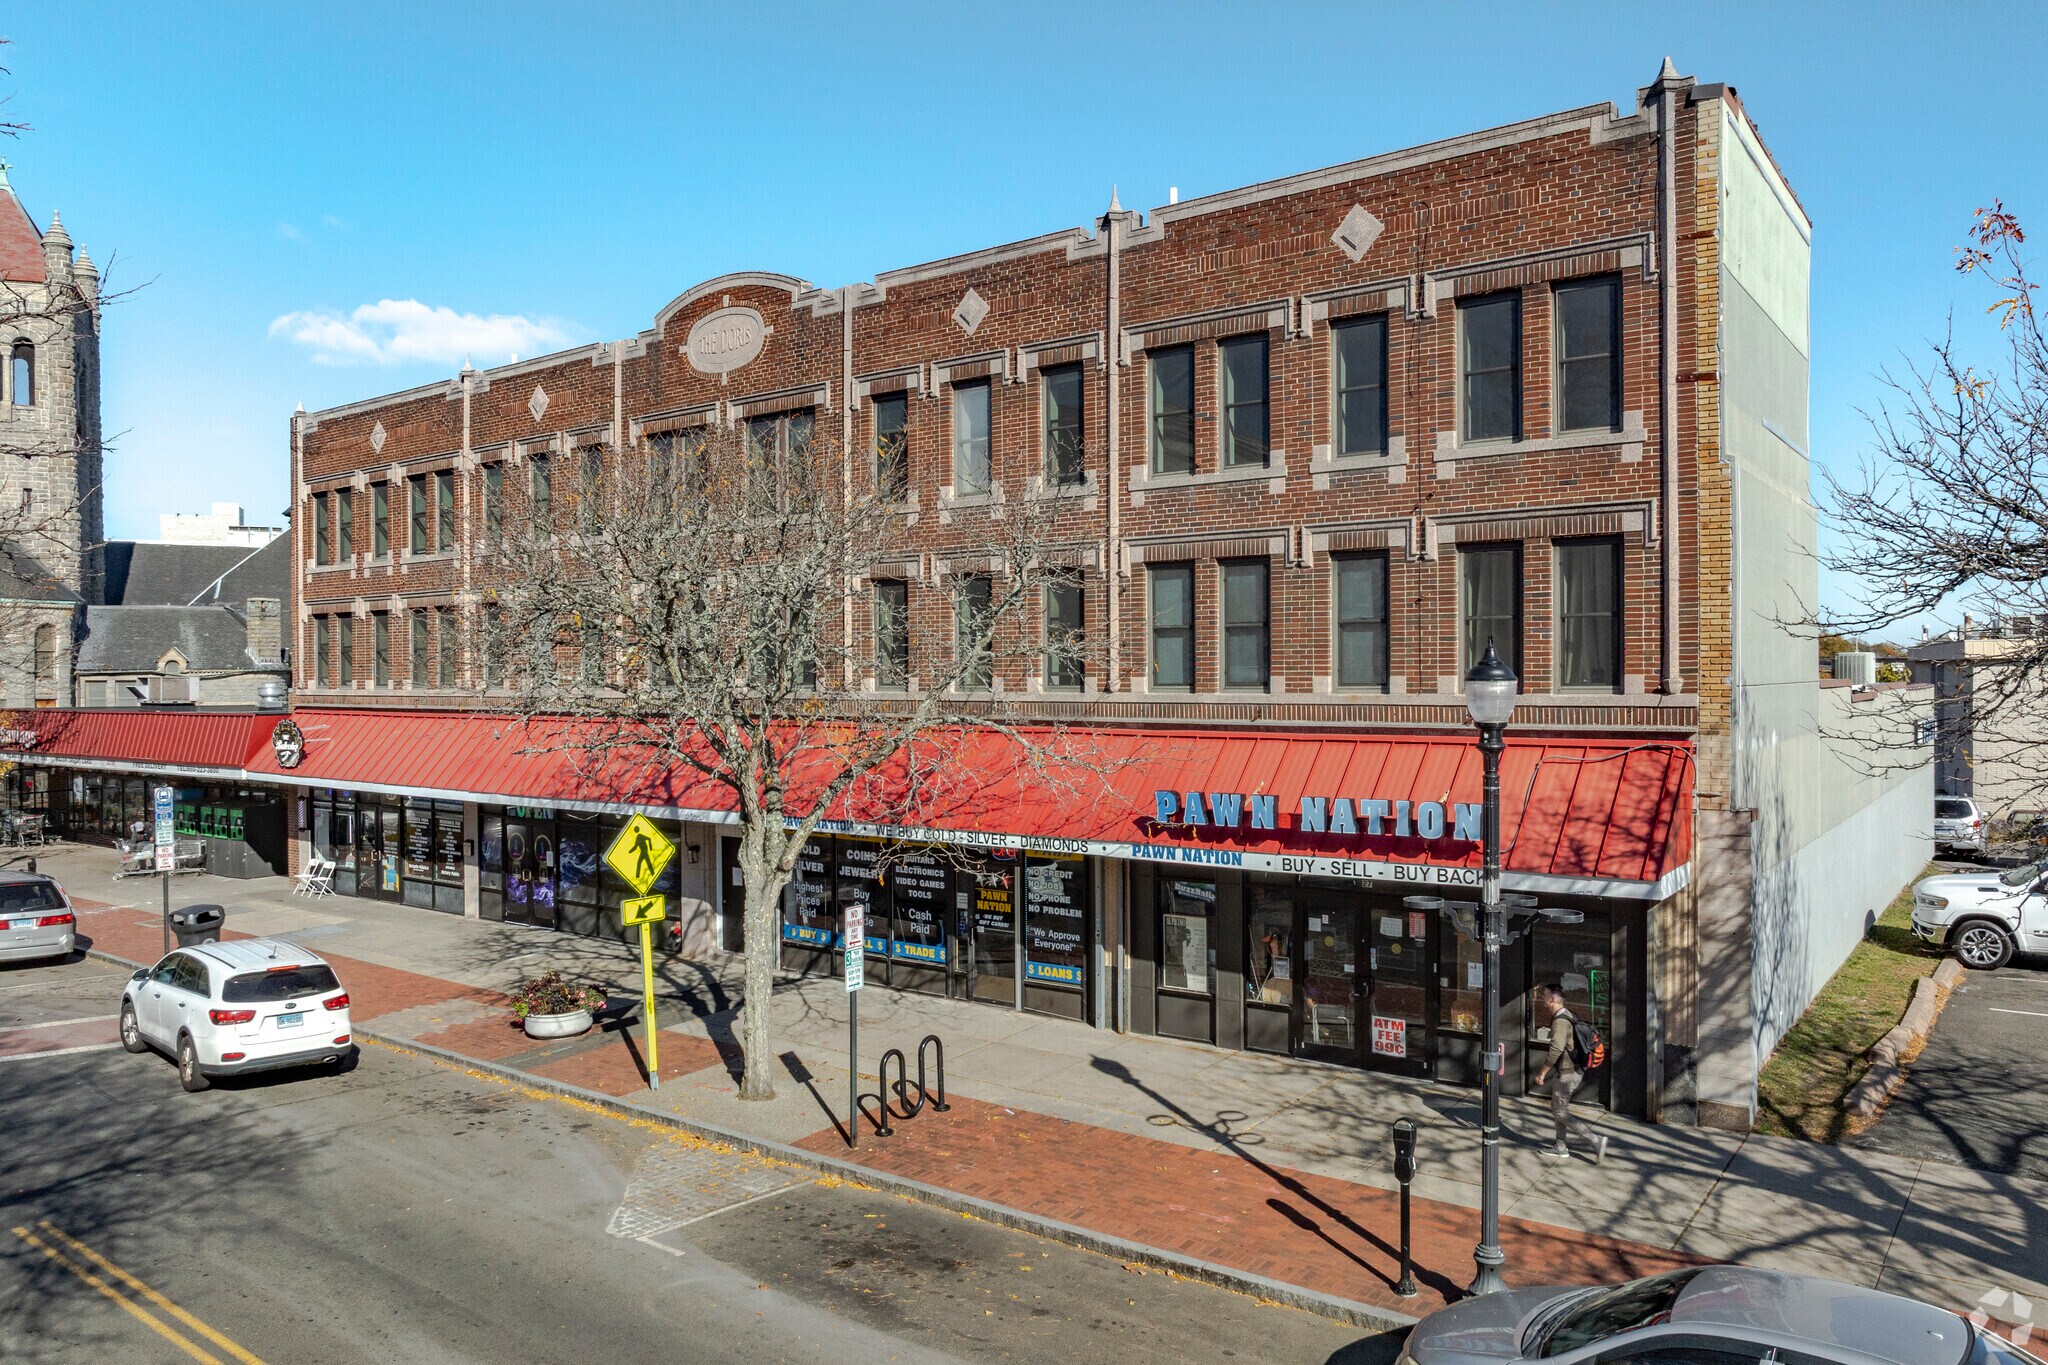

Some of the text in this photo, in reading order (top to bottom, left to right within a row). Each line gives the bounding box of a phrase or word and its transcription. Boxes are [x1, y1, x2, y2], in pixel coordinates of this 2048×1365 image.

[699, 327, 752, 355] THE DORIS
[1154, 790, 1483, 841] PAWN NATION
[814, 819, 855, 832] NATION
[876, 824, 893, 837] WE
[898, 826, 920, 839] BUY
[924, 828, 956, 842] GOLD
[967, 831, 1007, 846] SILVER
[1021, 836, 1089, 853] DIAMONDS
[800, 844, 820, 856] OLD
[846, 849, 877, 862] COINS
[1132, 844, 1243, 867] PAWN NATION
[793, 860, 824, 873] SILVER
[904, 855, 935, 865] GUITARS
[895, 865, 945, 878] ELECTRONICS
[1028, 867, 1073, 879] NO CREDIT
[1282, 858, 1315, 873] BUY
[1330, 861, 1373, 878] SELL
[1394, 866, 1431, 882] BUY
[793, 880, 824, 893] Highest
[895, 877, 945, 890] VIDEO GAMES
[1028, 880, 1059, 890] NO JOB
[1362, 880, 1372, 888] 27
[795, 893, 820, 906] Prices
[853, 888, 870, 901] Buy
[908, 889, 932, 899] TOOLS
[981, 890, 1007, 902] PAWN
[1028, 892, 1071, 904] NO PHONE
[800, 906, 817, 918] Paid
[976, 900, 1012, 912] NATION
[1028, 904, 1082, 918] NO PROBLEM
[850, 910, 858, 919] NO
[908, 908, 932, 921] Cash
[846, 919, 863, 929] PARKING
[910, 922, 930, 935] Paid
[800, 928, 816, 939] BUY
[1048, 929, 1080, 942] Approve
[904, 944, 935, 958] TRADE
[1038, 965, 1073, 980] LOANS
[1373, 1017, 1404, 1031] ATM
[1377, 1029, 1401, 1042] FEE
